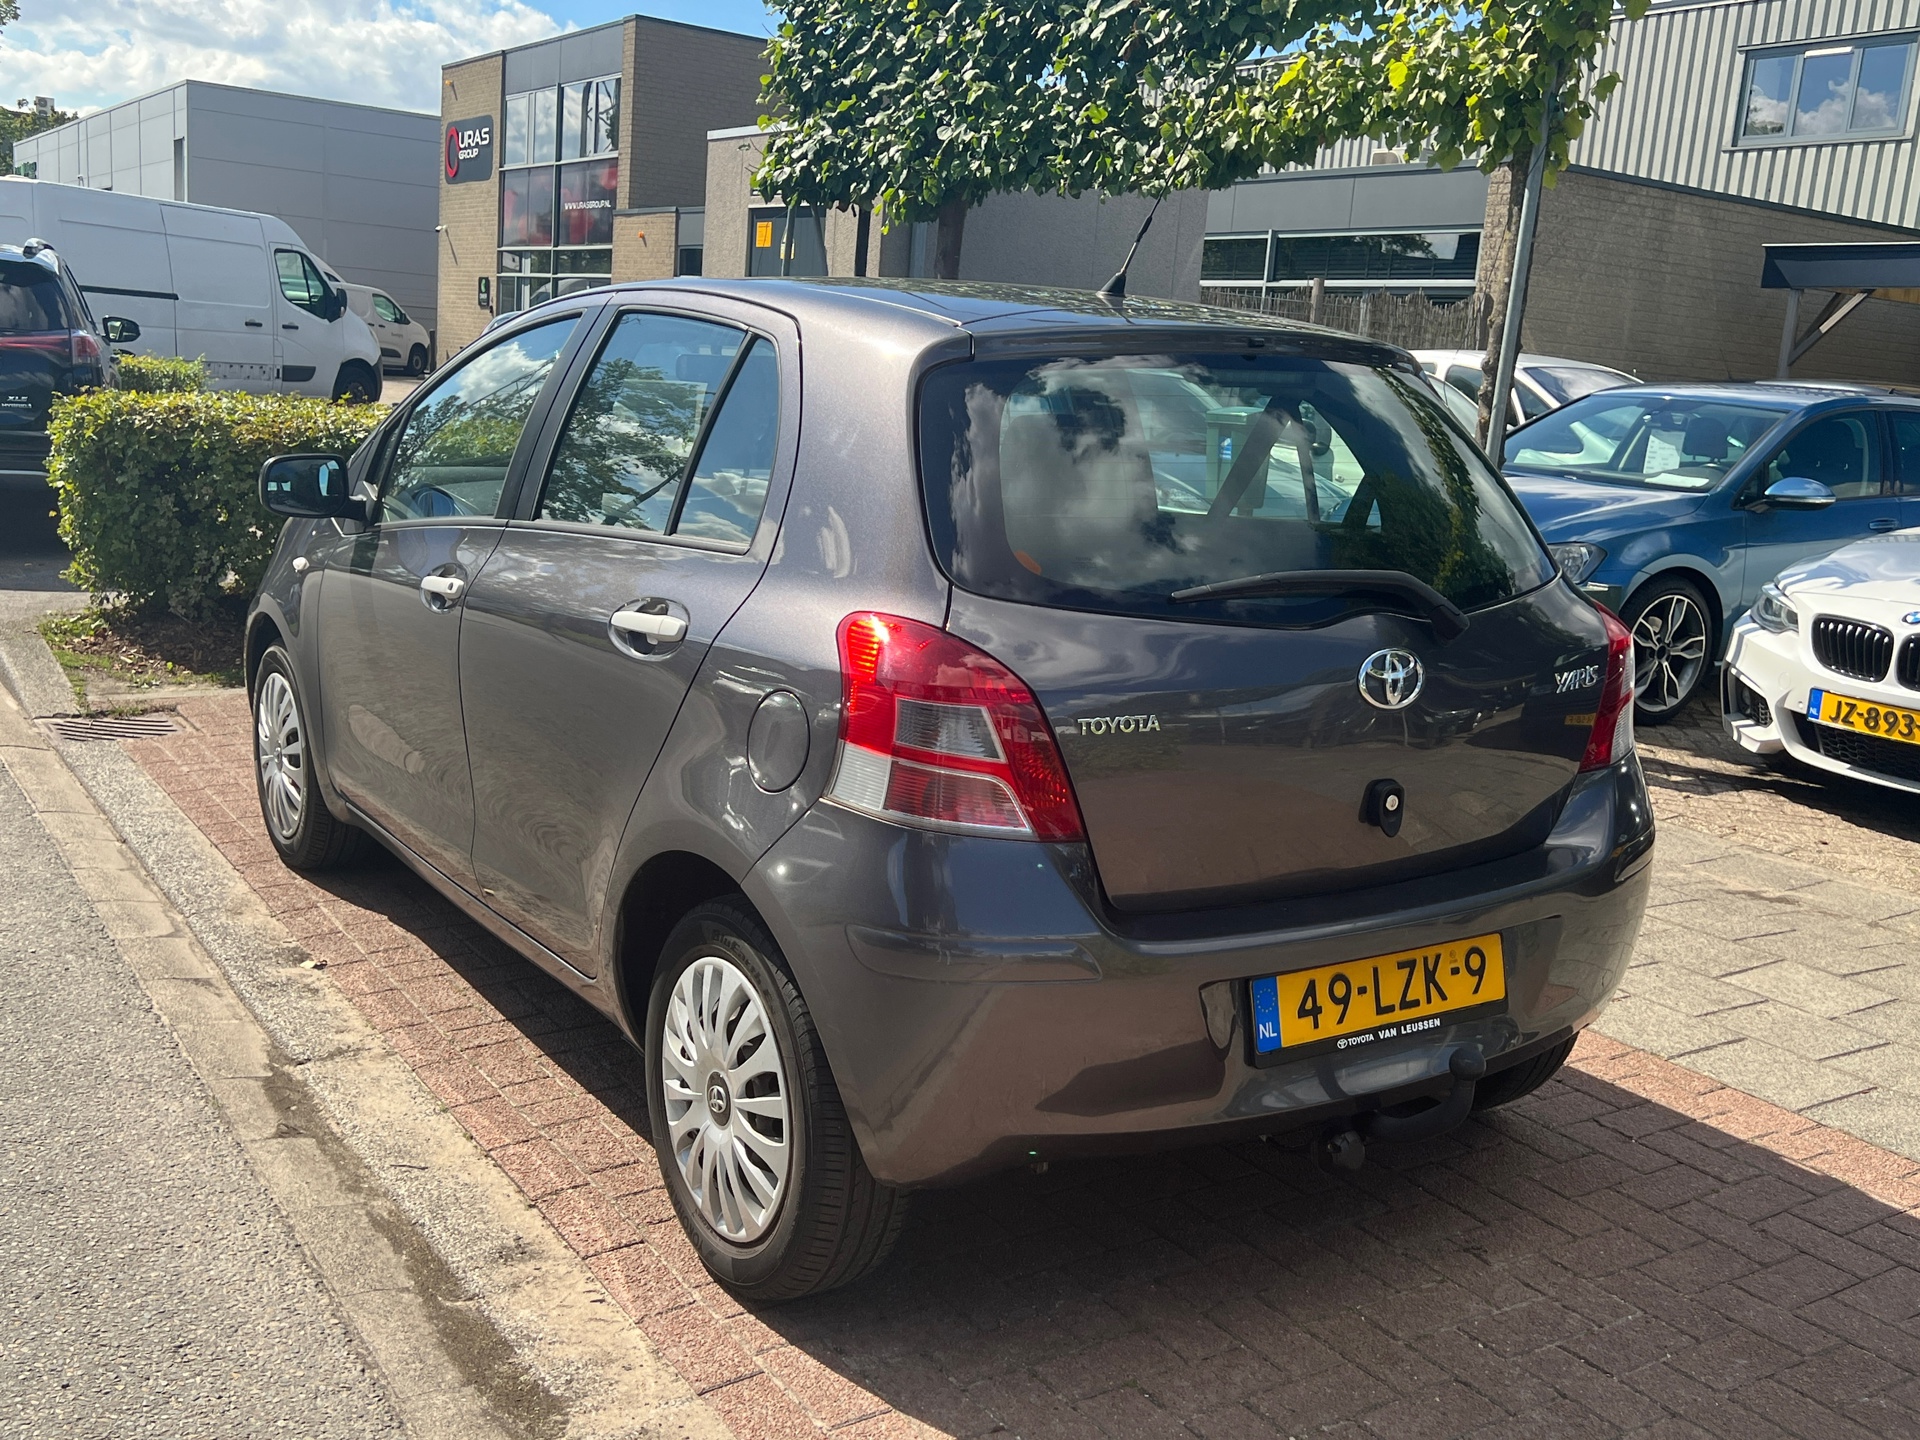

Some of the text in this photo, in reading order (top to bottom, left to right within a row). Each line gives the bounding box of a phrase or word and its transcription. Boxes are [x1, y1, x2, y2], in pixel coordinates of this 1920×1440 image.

[458, 148, 479, 160] GROUP
[1554, 665, 1599, 694] YARIS
[1809, 706, 1819, 716] NL
[1077, 714, 1161, 736] TOYOTA
[1296, 945, 1487, 1031] 49-LZK-9
[1258, 1022, 1278, 1040] NL
[1347, 1017, 1441, 1047] TOYOTA VAN LEUSSEN
